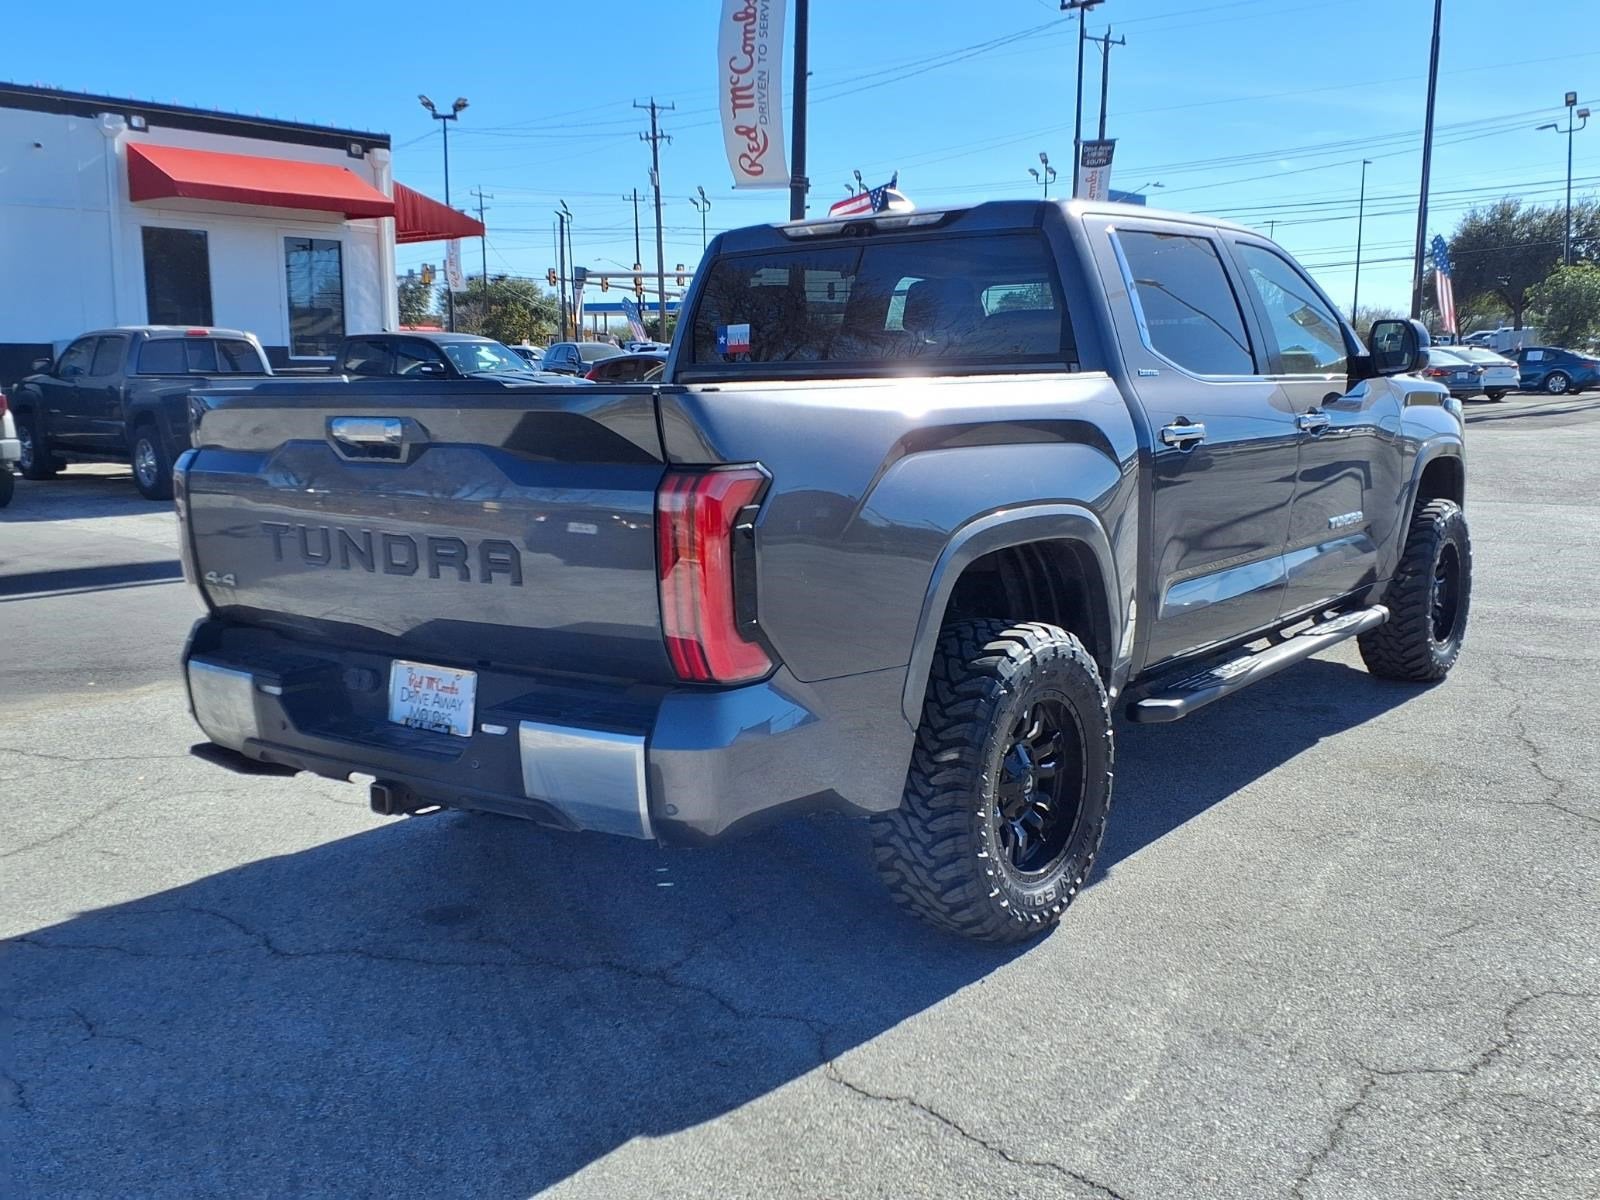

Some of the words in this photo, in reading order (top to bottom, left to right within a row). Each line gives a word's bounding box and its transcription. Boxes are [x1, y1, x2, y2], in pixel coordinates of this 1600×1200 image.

[758, 0, 770, 38] SERV
[758, 43, 768, 64] TO
[757, 71, 768, 125] DRIVEN
[734, 124, 769, 176] Red
[259, 520, 524, 587] TUNDRA
[400, 686, 430, 706] DRIVE
[432, 692, 464, 712] AWAY
